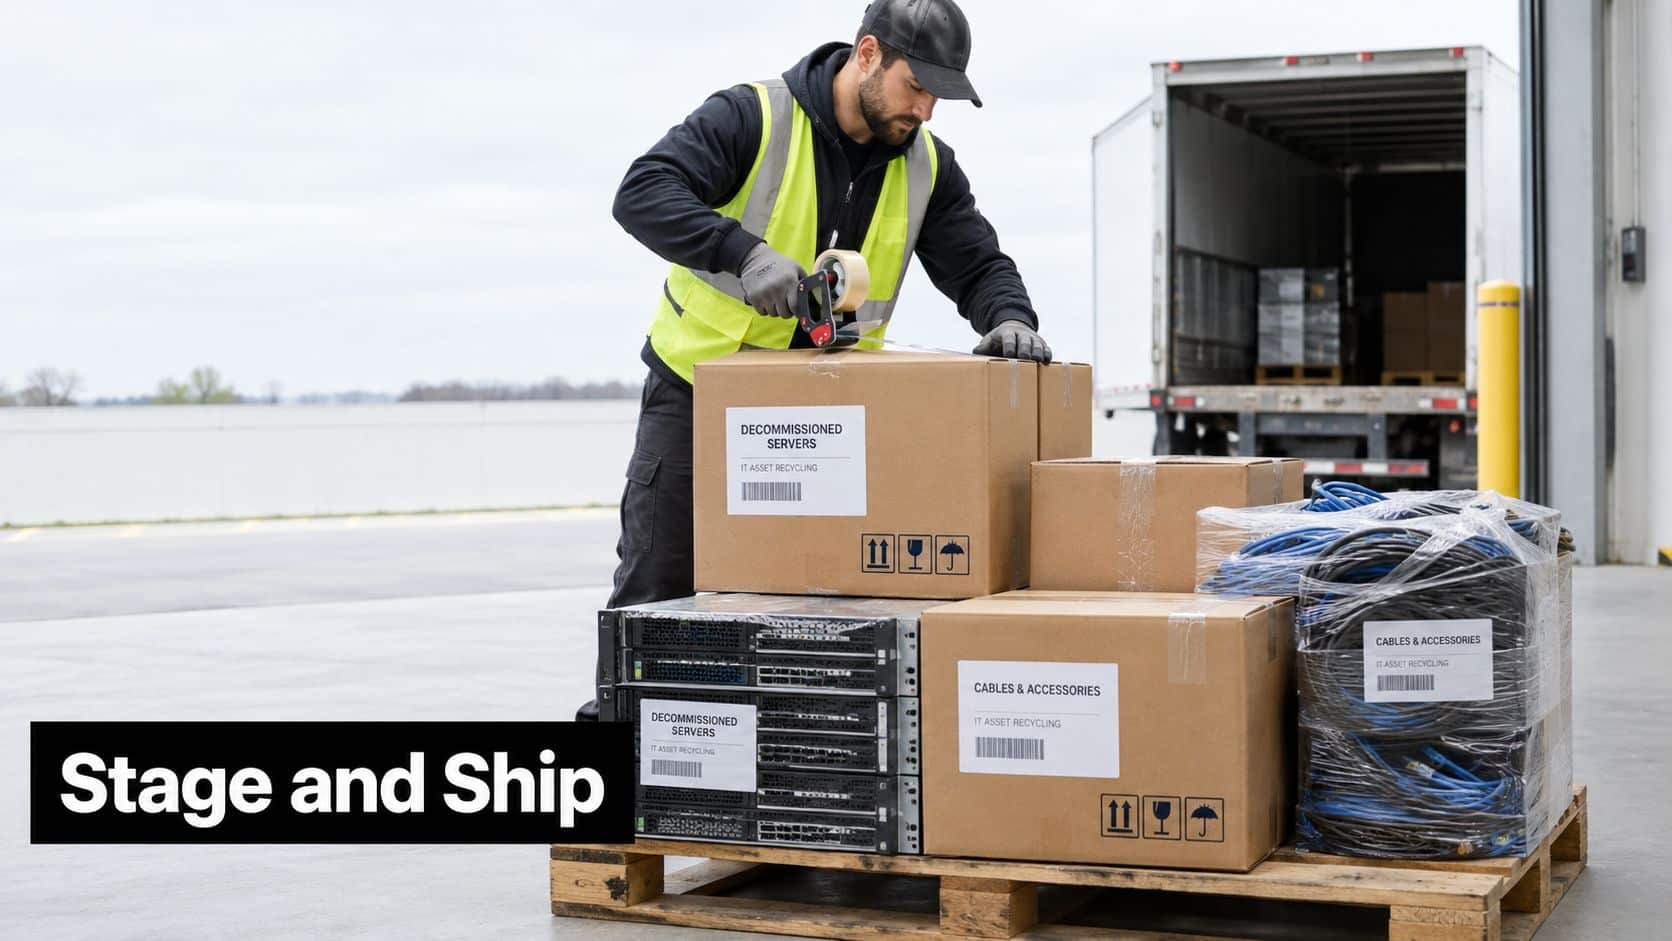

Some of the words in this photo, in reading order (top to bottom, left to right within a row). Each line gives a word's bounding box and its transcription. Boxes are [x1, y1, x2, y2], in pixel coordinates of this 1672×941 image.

[740, 424, 843, 435] DECOMMISSIONED
[767, 438, 817, 449] SERVERS
[741, 464, 747, 472] IT
[749, 464, 773, 472] ASSET
[775, 464, 818, 472] RECYCLING
[1376, 637, 1411, 647] CABLES
[1413, 637, 1419, 646] &
[1421, 635, 1481, 646] ACCESSORIES
[1384, 660, 1407, 668] ASSET
[1408, 659, 1449, 668] RECYCLING
[974, 682, 1015, 694] CABLES
[1017, 683, 1024, 695] &
[1027, 684, 1101, 697] ACCESSORIES
[651, 712, 738, 726] DECOMMISSIONED
[974, 717, 981, 726] IT
[984, 717, 1011, 727] ASSET
[1013, 718, 1062, 728] RECYCLING
[671, 726, 716, 737] SERVERS
